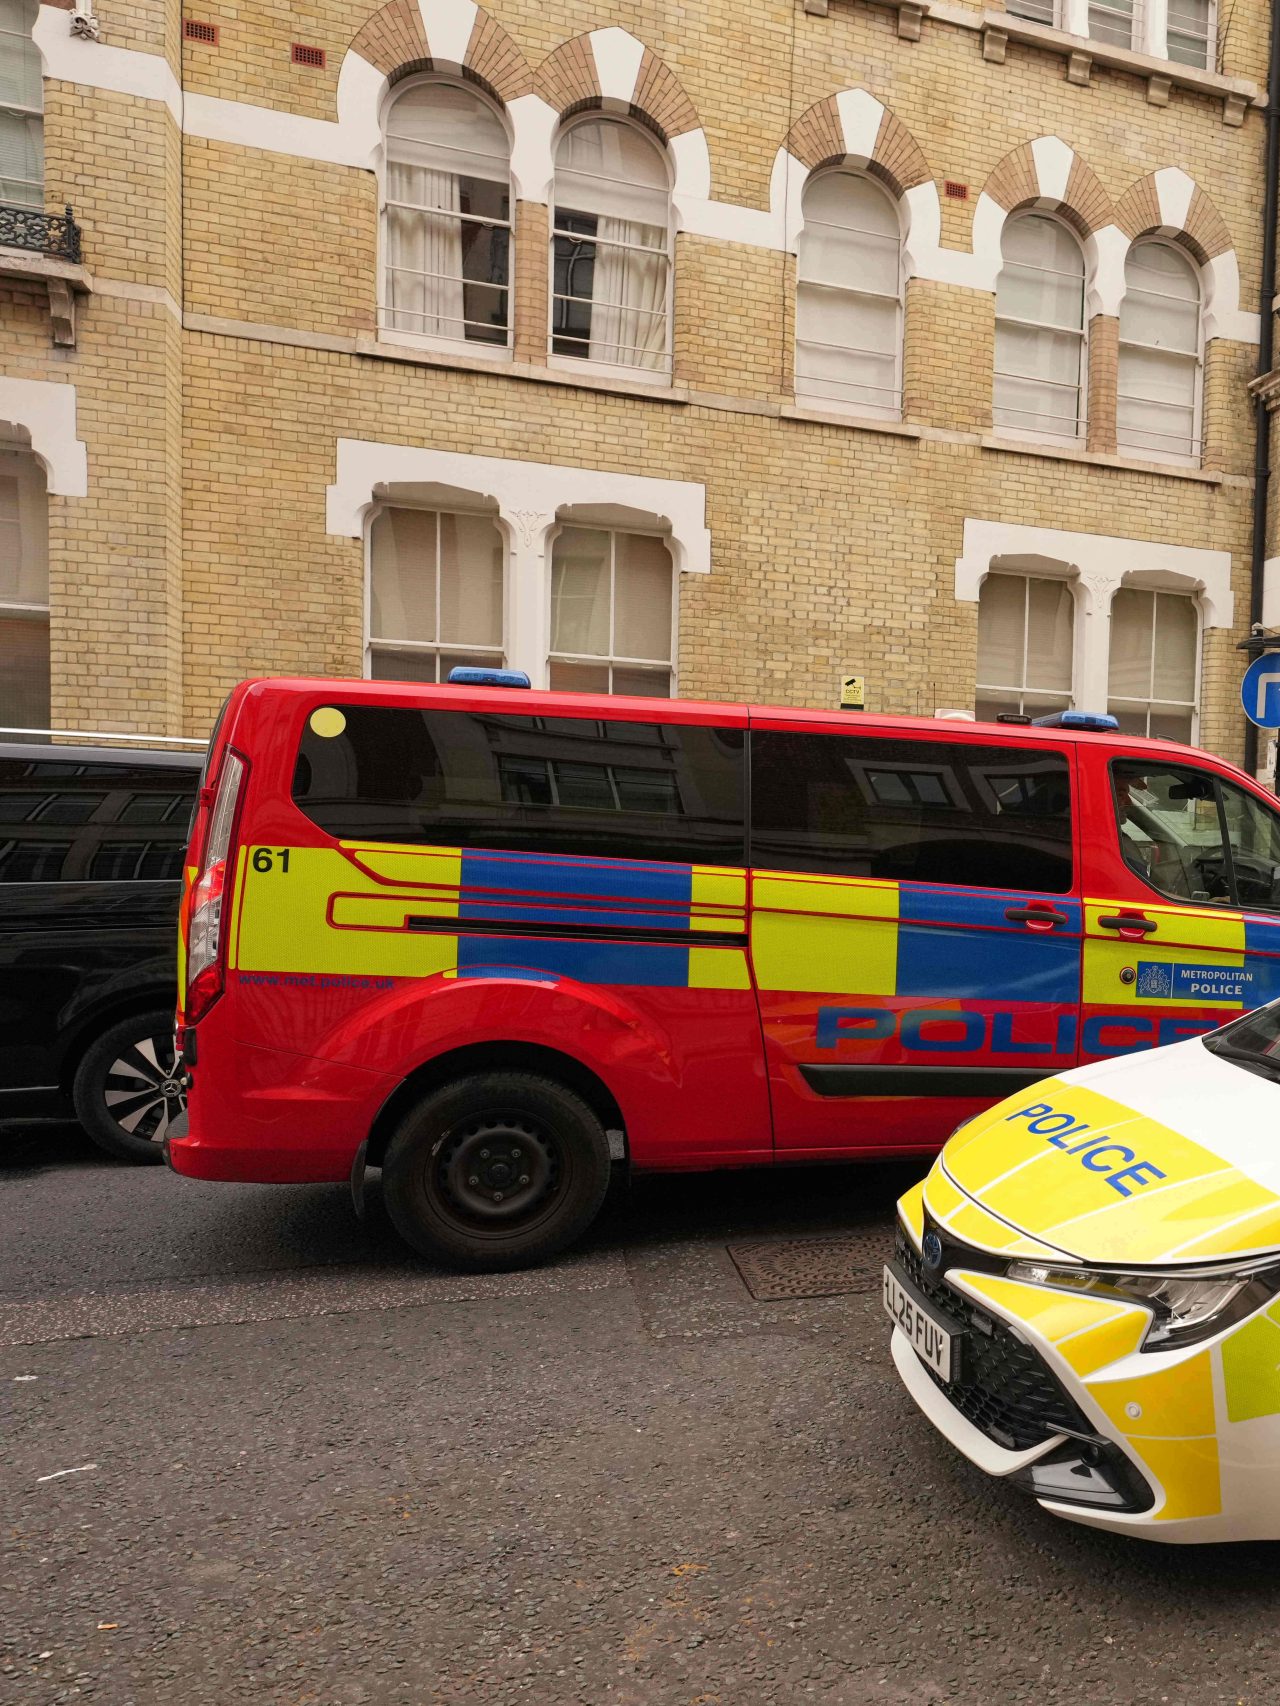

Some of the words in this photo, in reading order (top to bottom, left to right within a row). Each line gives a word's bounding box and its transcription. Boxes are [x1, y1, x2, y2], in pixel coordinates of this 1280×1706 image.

[252, 847, 290, 873] 61
[239, 974, 395, 990] www.met.police.uk
[1181, 969, 1253, 982] METROPOLITAN
[1190, 983, 1243, 995] POLICE
[1005, 1103, 1167, 1197] POLICE
[886, 1274, 913, 1336] LL25
[916, 1311, 943, 1367] FUV
